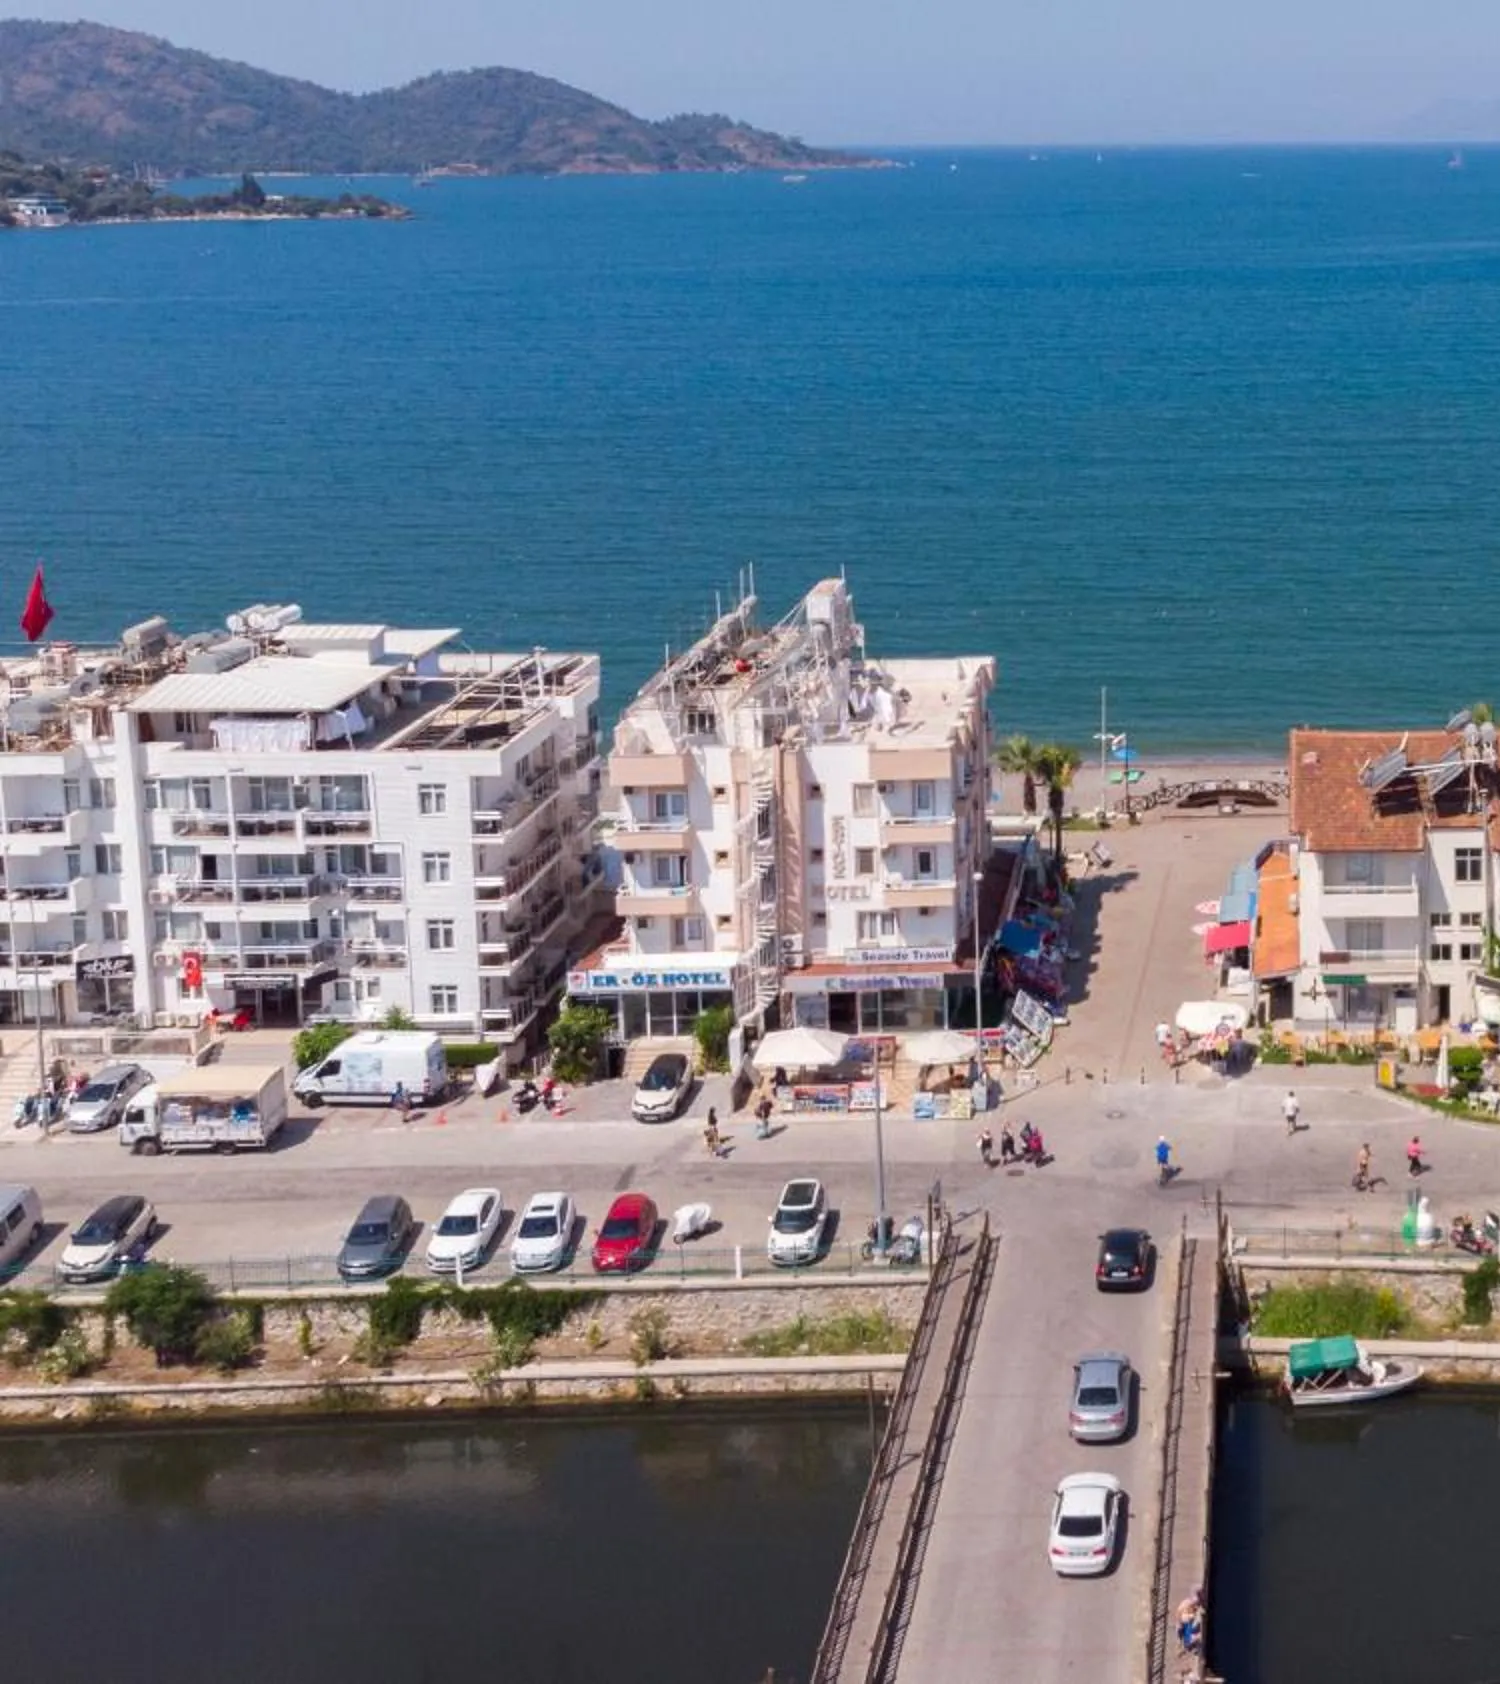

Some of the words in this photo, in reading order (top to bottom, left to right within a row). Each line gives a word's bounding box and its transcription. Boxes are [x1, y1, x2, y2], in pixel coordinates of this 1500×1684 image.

[861, 951, 909, 961] Seaside
[912, 950, 949, 960] Travel
[592, 975, 618, 986] ER
[662, 972, 726, 986] HOTEL
